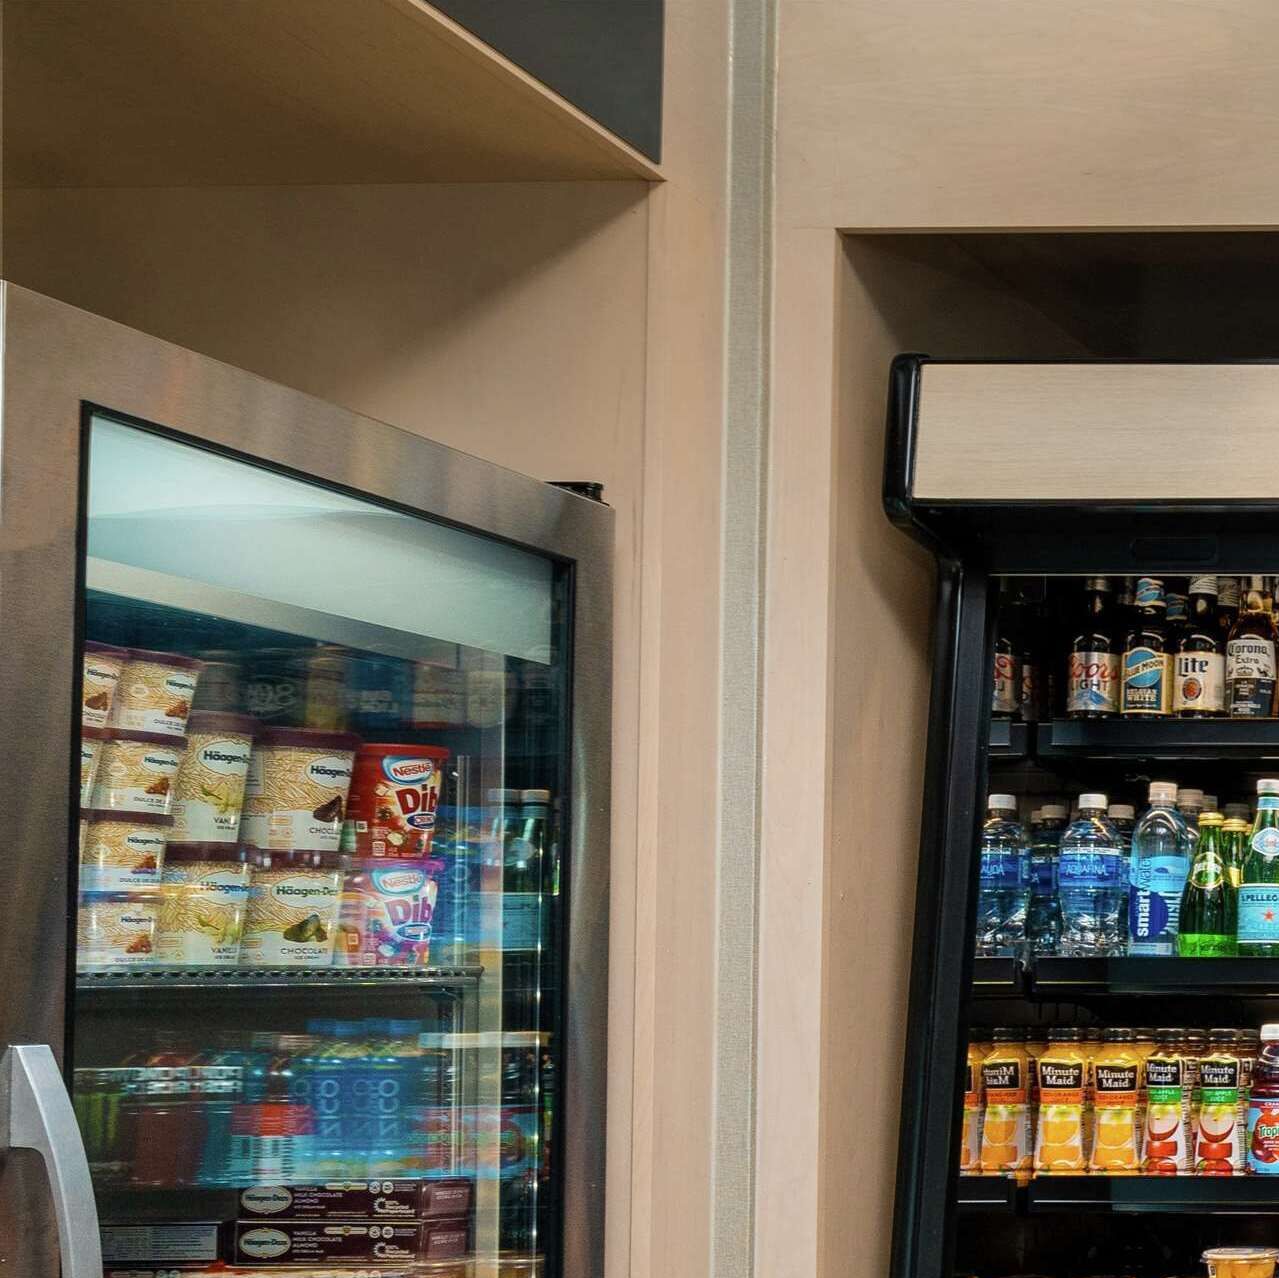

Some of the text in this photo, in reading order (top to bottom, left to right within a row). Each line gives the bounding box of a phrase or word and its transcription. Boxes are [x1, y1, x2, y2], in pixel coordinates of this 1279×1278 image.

[1229, 642, 1270, 656] Corona
[1235, 654, 1260, 665] Extra
[1179, 656, 1209, 677] Lite
[1042, 1066, 1079, 1076] Minute
[1147, 1062, 1177, 1073] Minute
[1200, 1064, 1234, 1074] Minute
[1045, 1075, 1074, 1085] Maid
[1098, 1070, 1134, 1080] Minute
[1150, 1072, 1173, 1082] Maid
[1204, 1074, 1230, 1083] Maid
[1102, 1079, 1129, 1088] Maid
